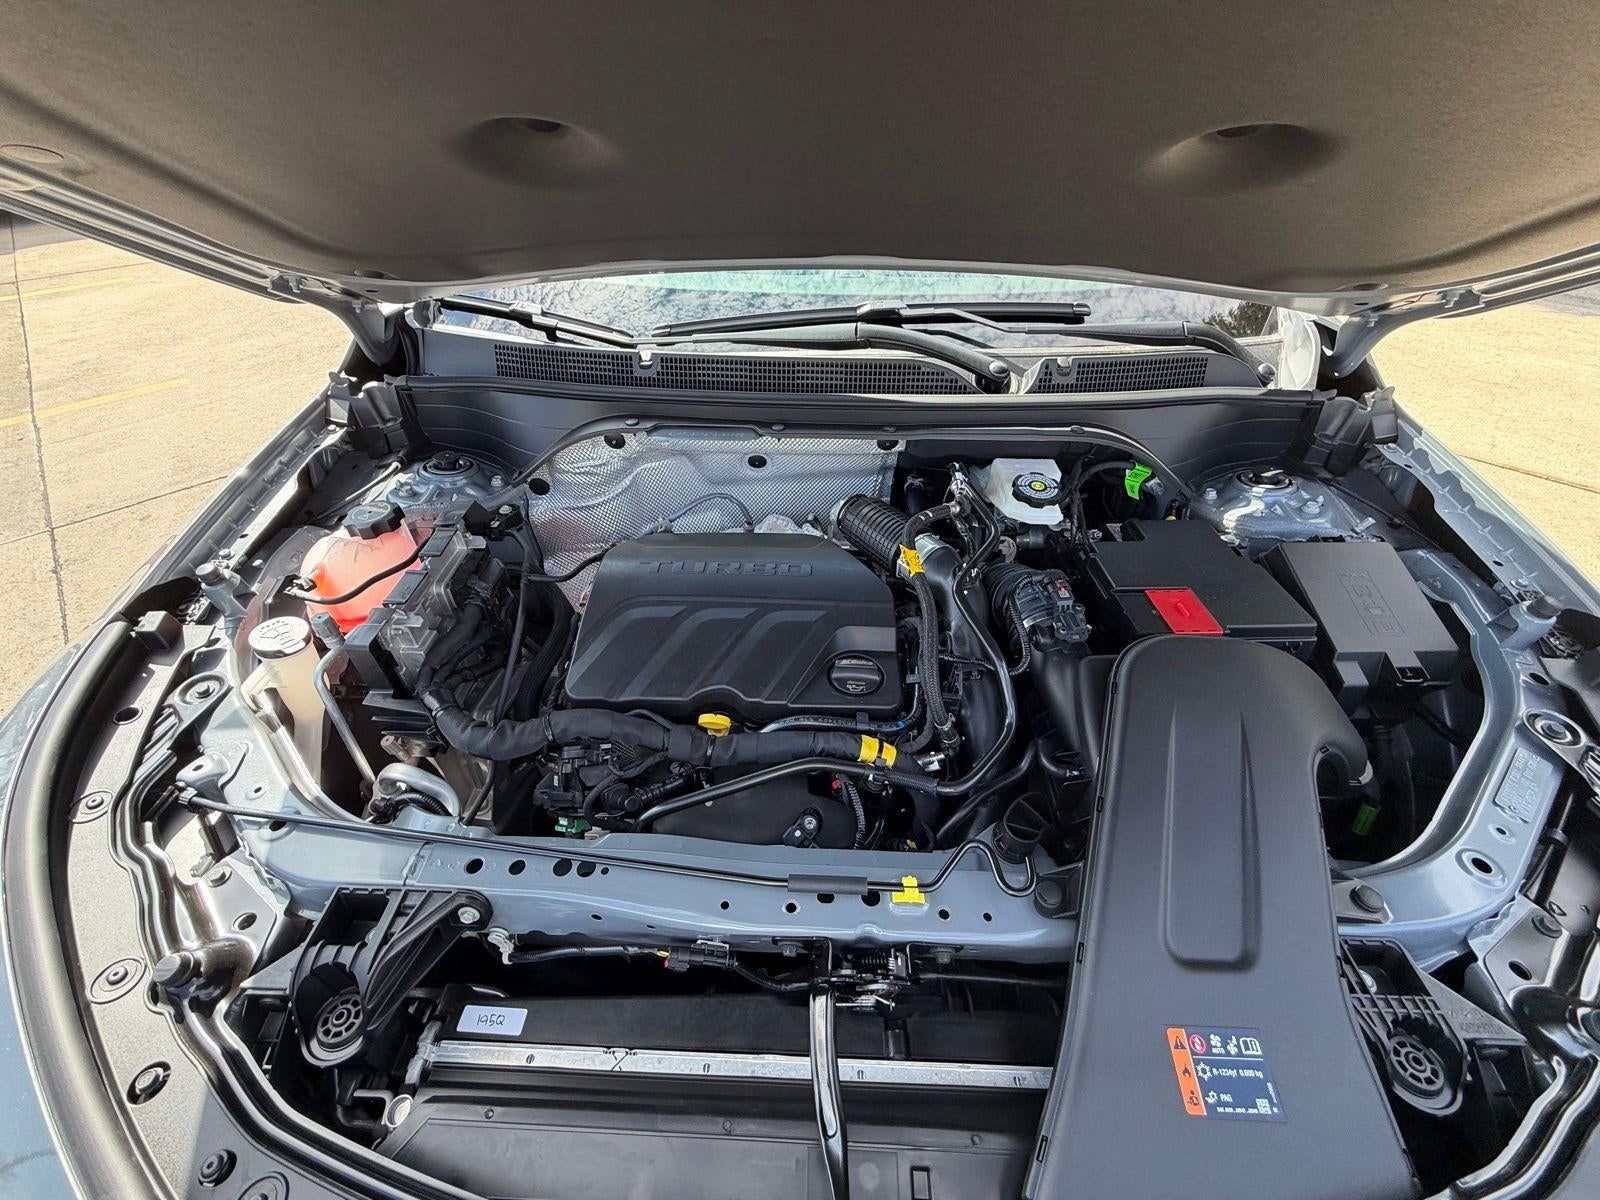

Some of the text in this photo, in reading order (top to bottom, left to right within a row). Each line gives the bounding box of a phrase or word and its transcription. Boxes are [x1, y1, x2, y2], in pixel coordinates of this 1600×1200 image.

[639, 560, 813, 577] TURBO
[476, 1013, 505, 1026] 195Q
[1255, 1070, 1264, 1079] kg
[1220, 1093, 1233, 1102] PAG
